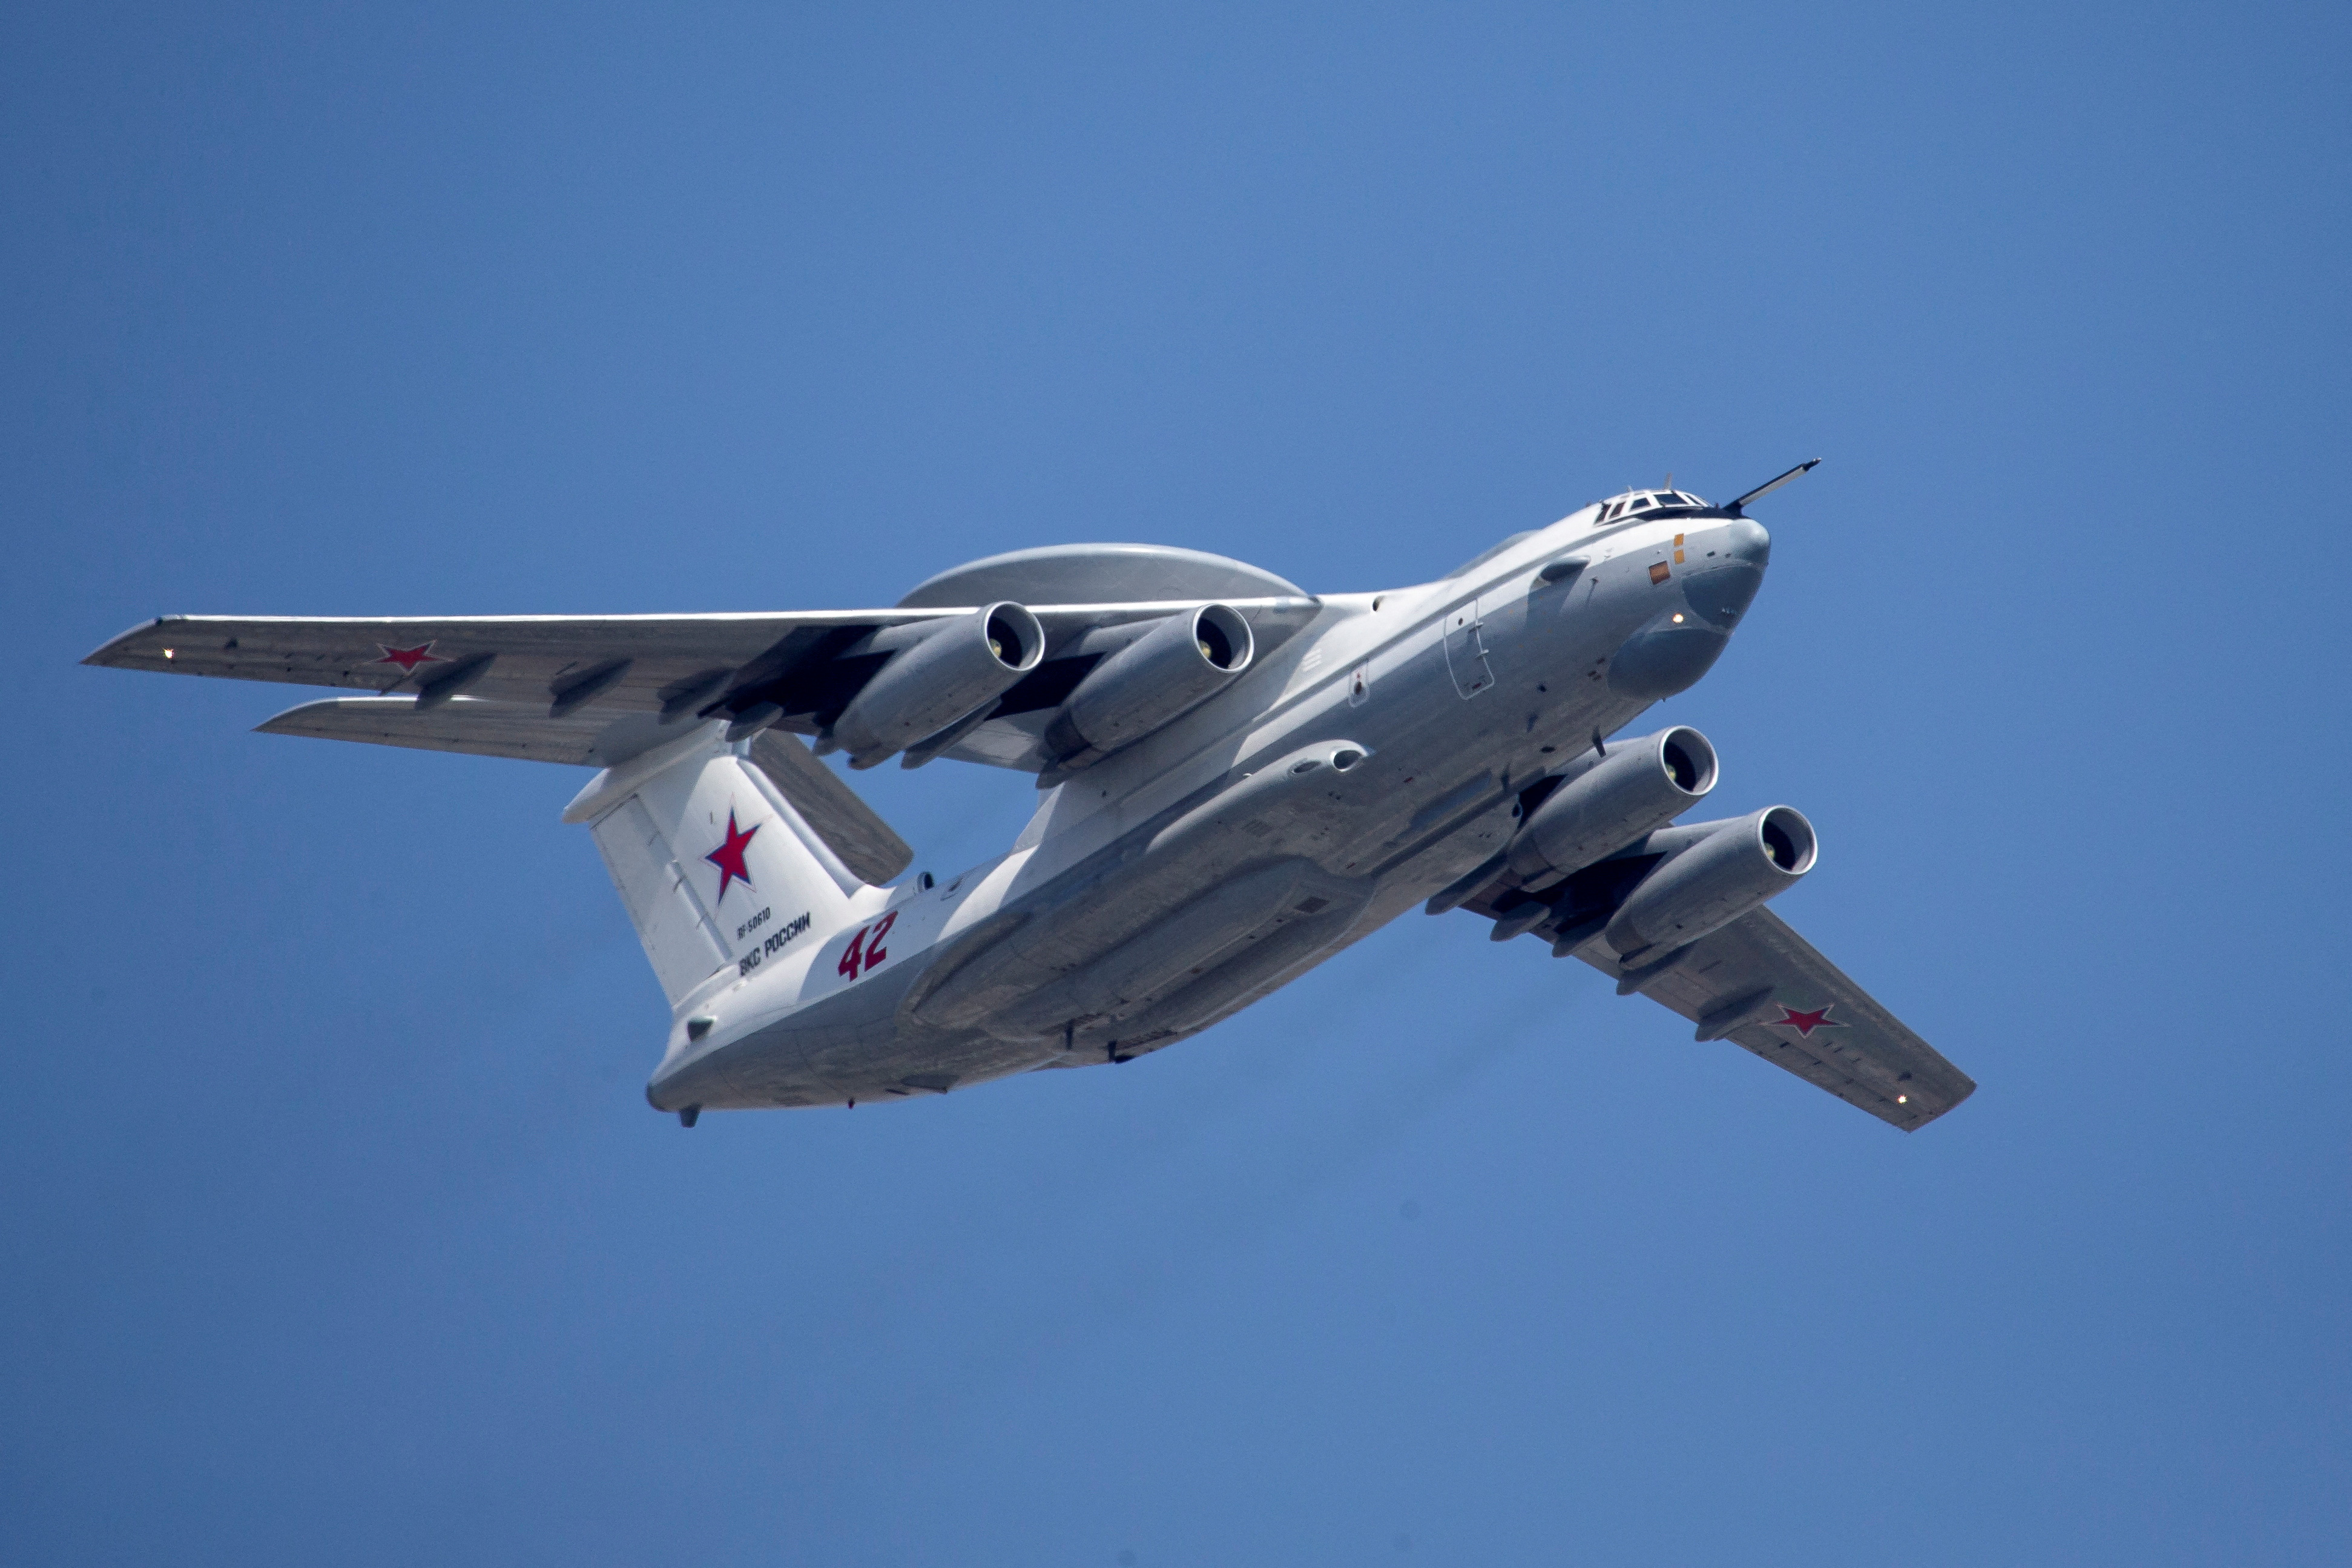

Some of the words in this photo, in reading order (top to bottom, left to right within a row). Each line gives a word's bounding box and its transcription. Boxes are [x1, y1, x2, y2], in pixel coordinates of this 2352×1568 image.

[739, 947, 761, 977] ВКС
[764, 911, 811, 958] РОССИИ
[838, 911, 898, 982] 42
